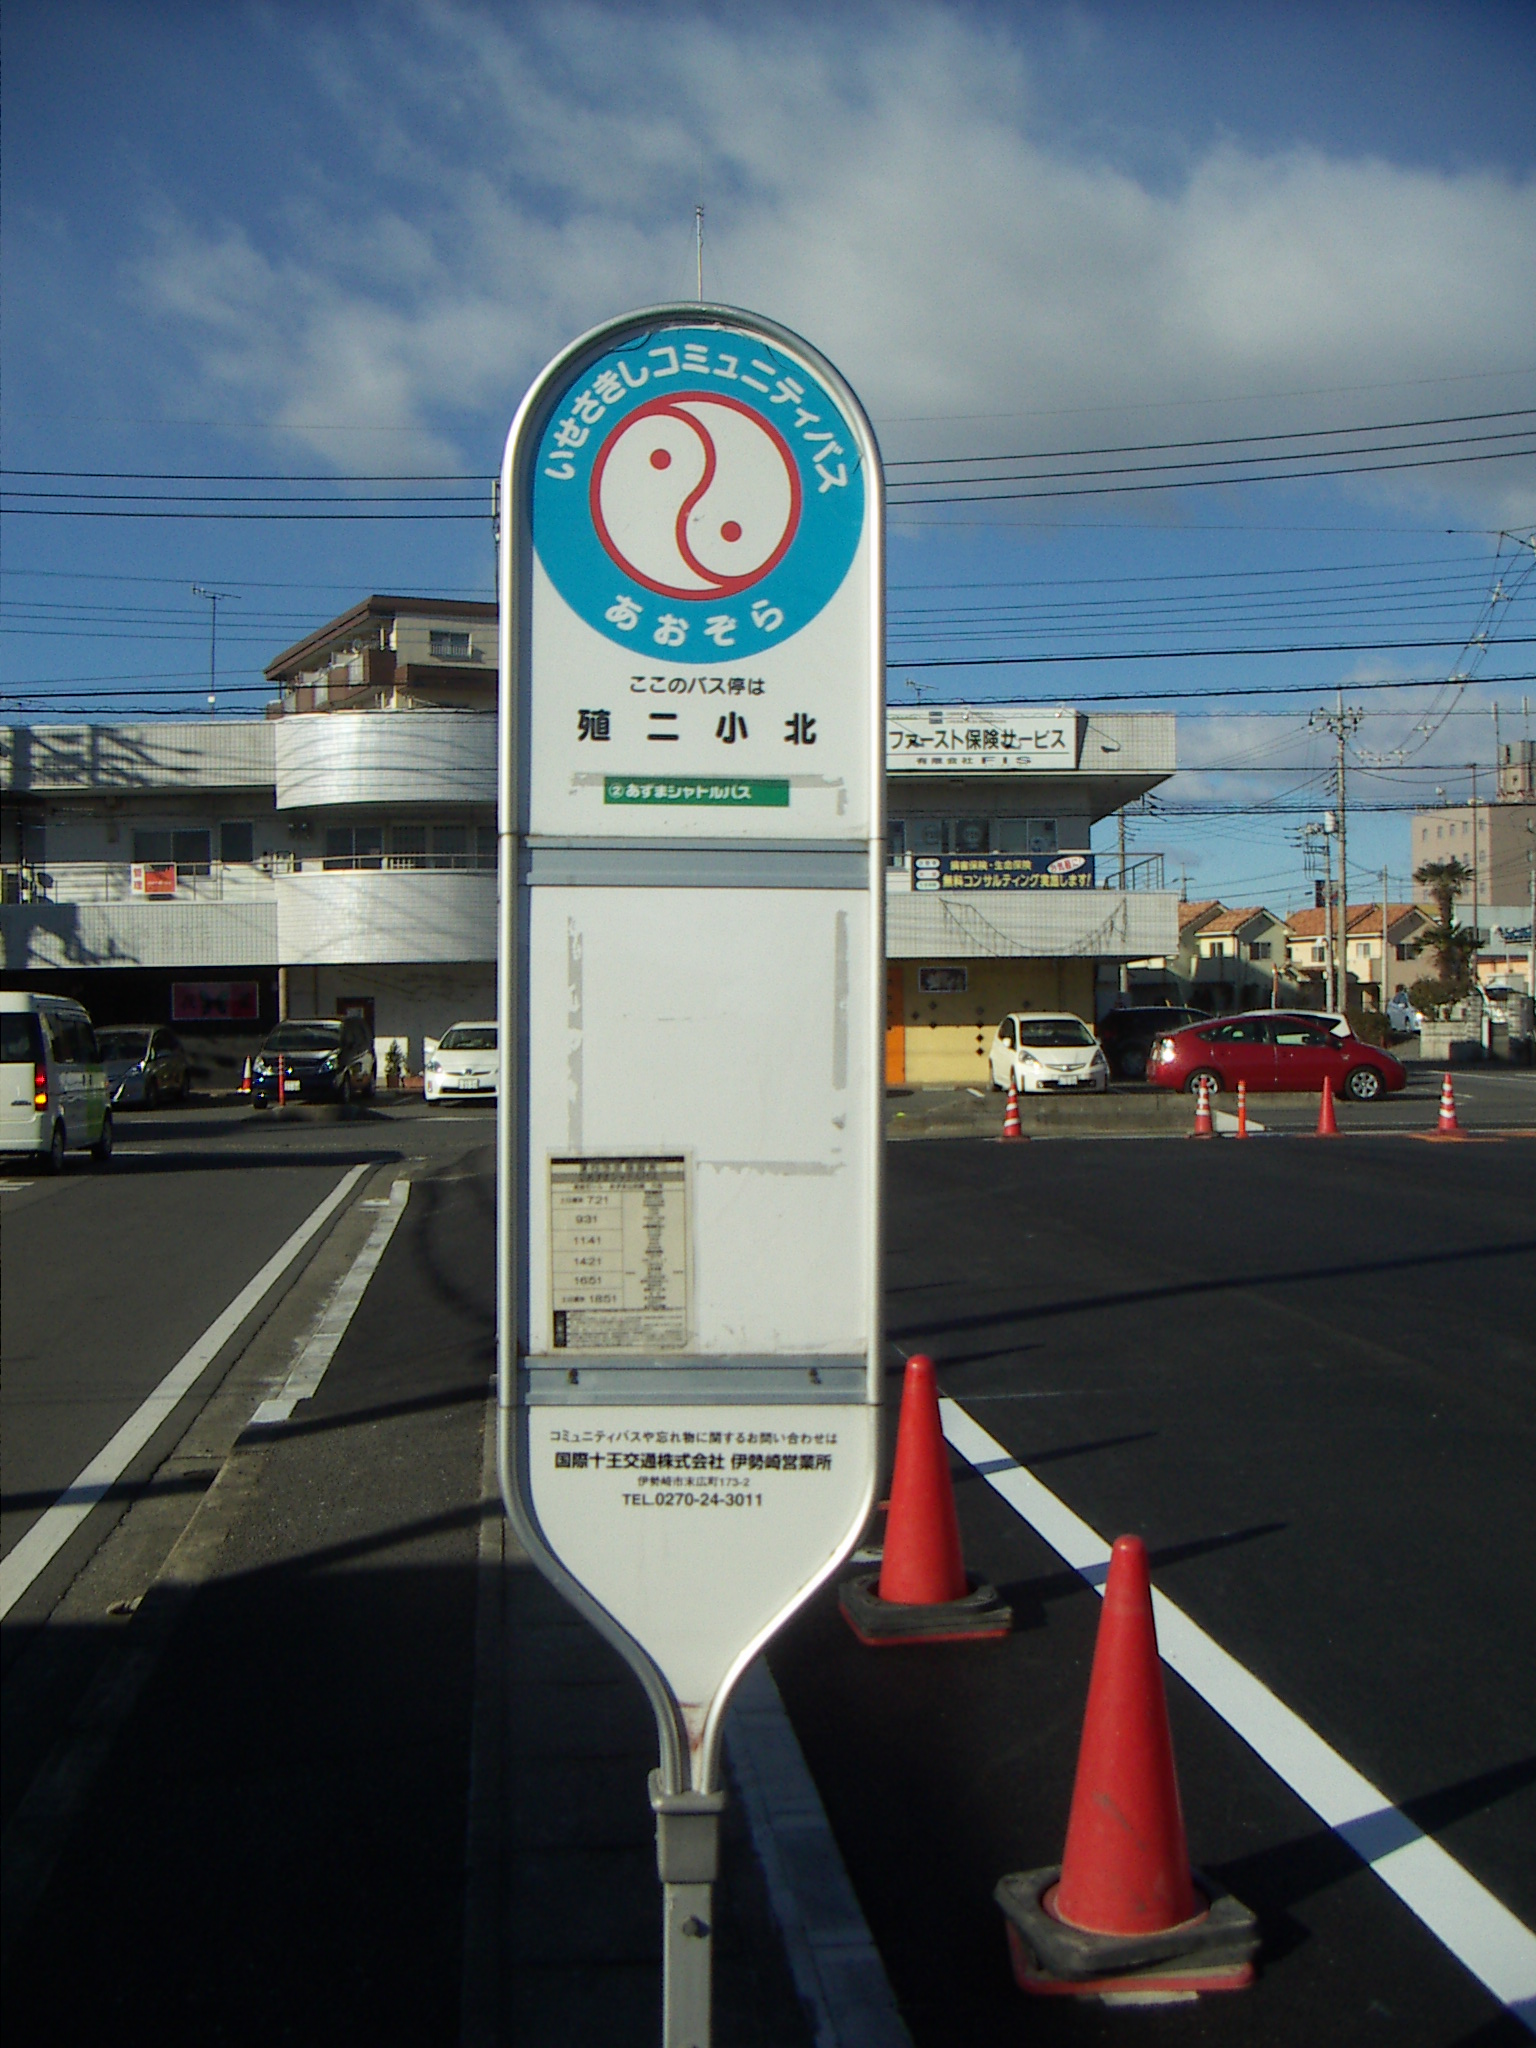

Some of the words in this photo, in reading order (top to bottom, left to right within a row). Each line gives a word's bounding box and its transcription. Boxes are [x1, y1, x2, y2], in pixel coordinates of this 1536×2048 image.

[544, 343, 848, 494] いせさきしコミュニティバス
[604, 595, 784, 648] あおぞら
[629, 676, 766, 696] ここのバス停は
